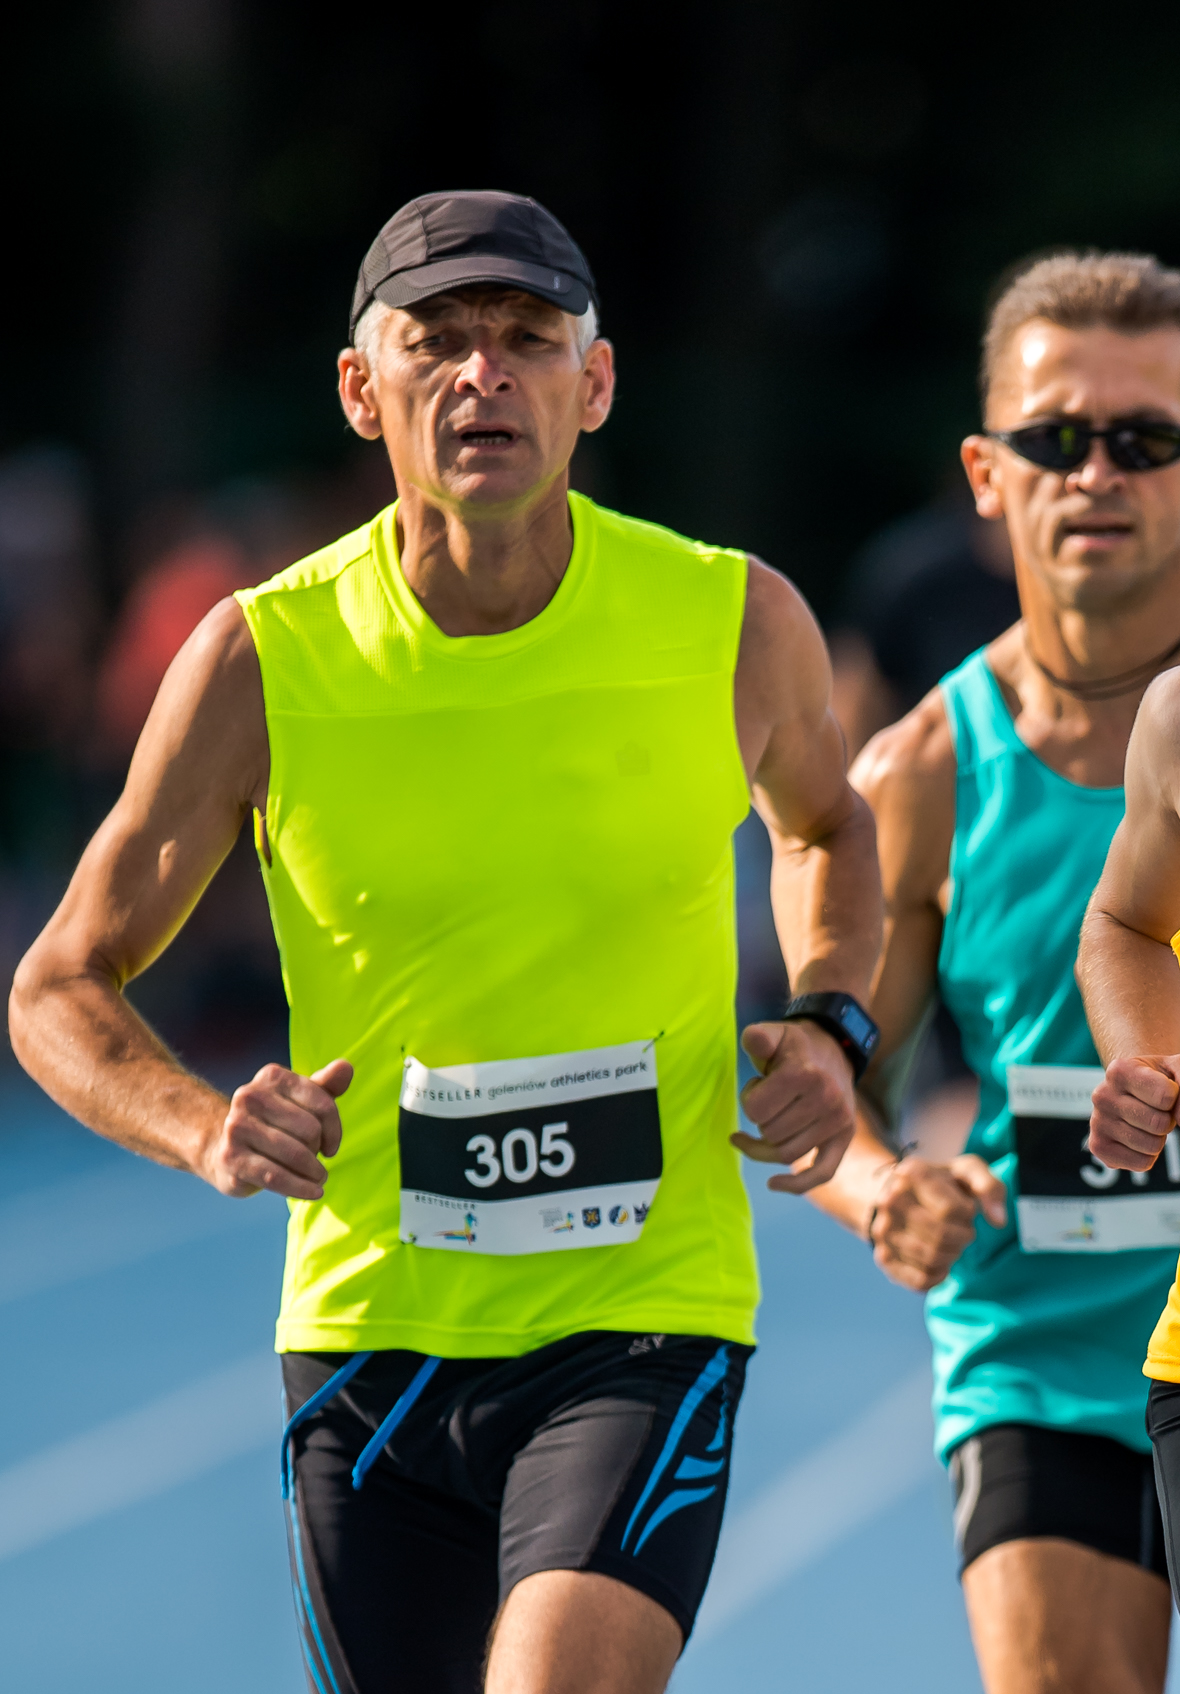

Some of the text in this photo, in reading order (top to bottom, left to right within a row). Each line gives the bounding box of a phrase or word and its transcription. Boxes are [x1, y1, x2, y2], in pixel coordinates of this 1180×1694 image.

[488, 1078, 547, 1100] goleniów
[550, 1067, 610, 1089] athletics
[614, 1060, 648, 1079] park
[463, 1121, 576, 1188] 305
